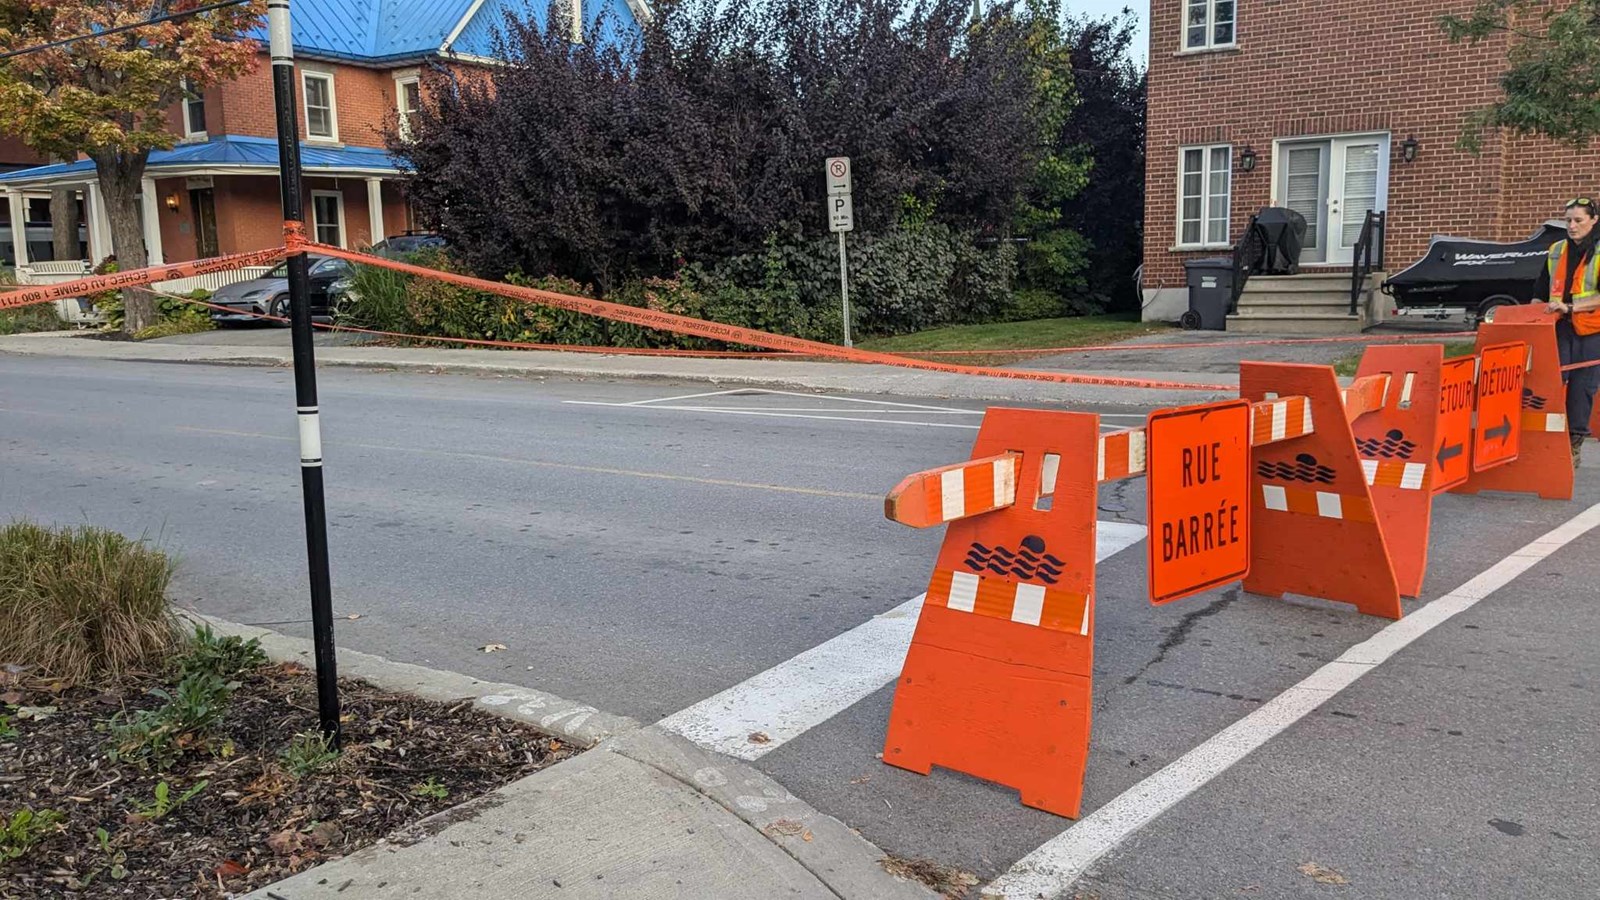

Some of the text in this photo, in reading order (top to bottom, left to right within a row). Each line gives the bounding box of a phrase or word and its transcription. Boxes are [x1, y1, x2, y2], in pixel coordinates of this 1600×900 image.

[835, 198, 845, 212] P
[1455, 250, 1550, 260] WAVERUNN
[52, 282, 88, 297] CRIME
[91, 278, 106, 289] AU
[21, 291, 41, 303] 800
[44, 290, 50, 298] 1
[1482, 362, 1522, 397] DÉTOUR
[1440, 379, 1472, 414] ÉTOUR
[1182, 442, 1221, 488] RUE
[1162, 499, 1239, 562] BARRÉE
